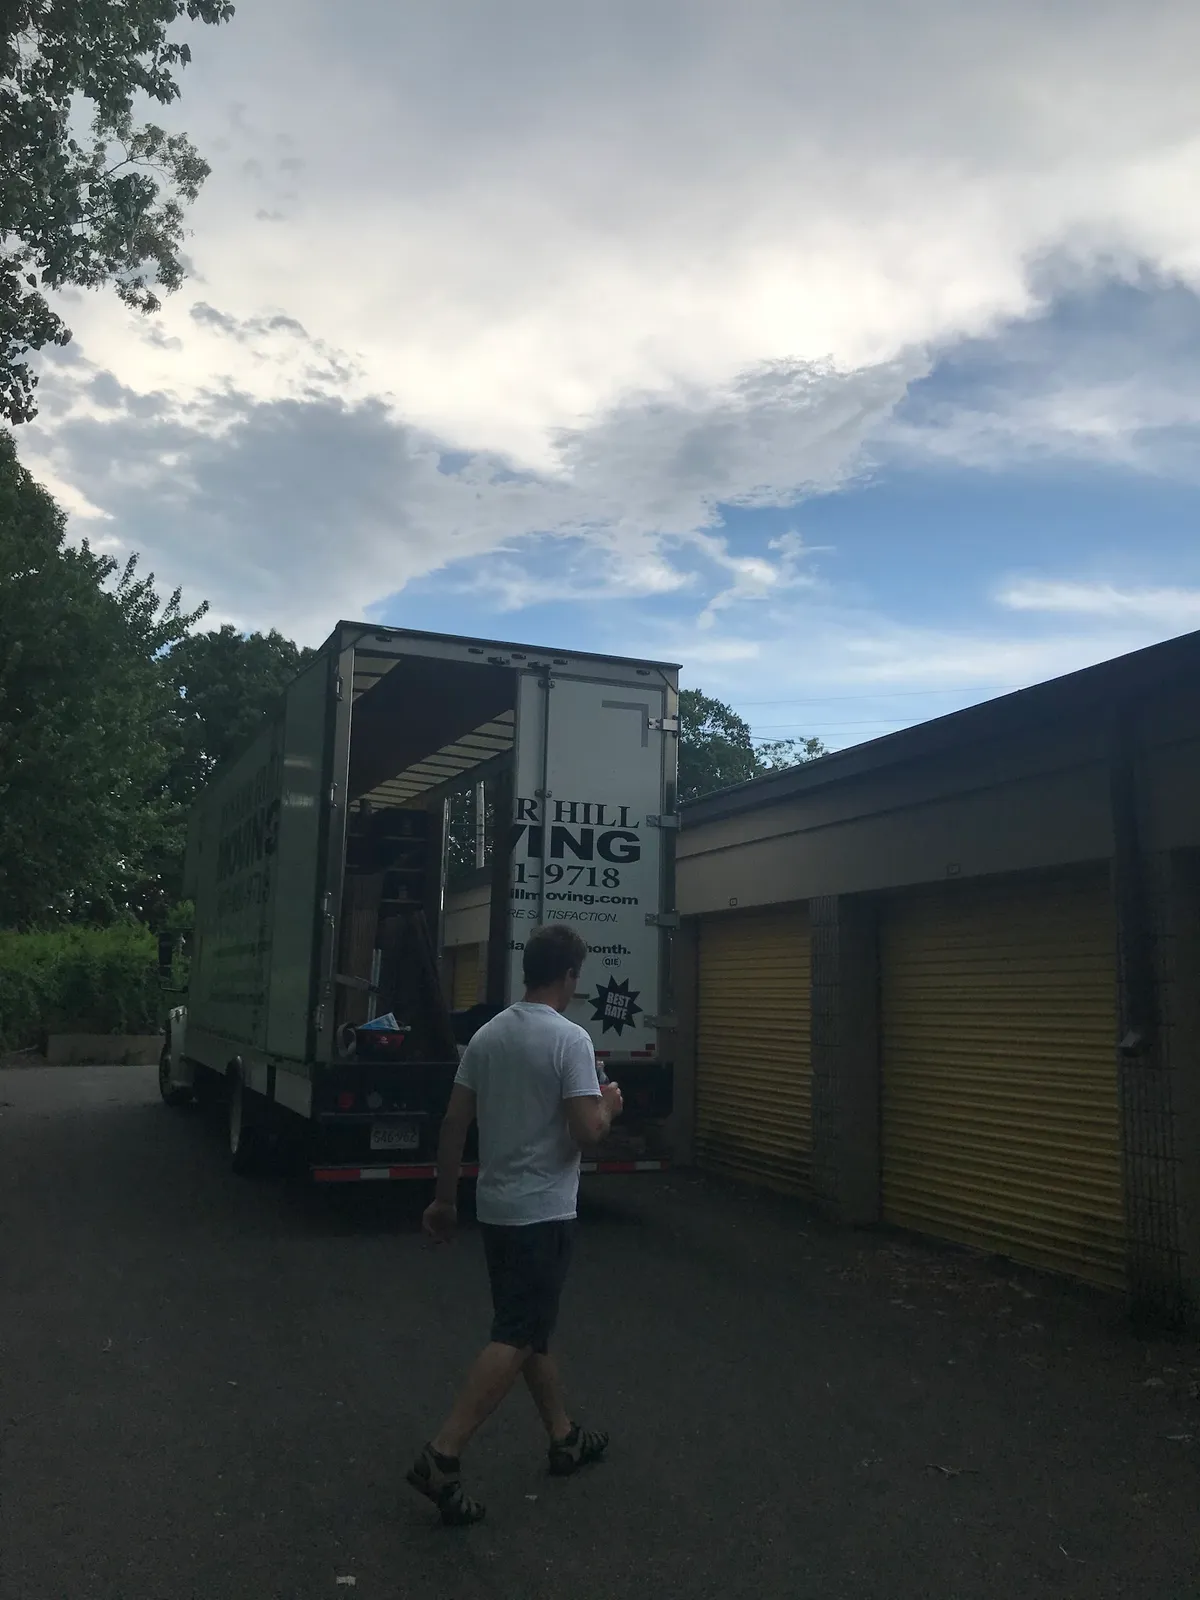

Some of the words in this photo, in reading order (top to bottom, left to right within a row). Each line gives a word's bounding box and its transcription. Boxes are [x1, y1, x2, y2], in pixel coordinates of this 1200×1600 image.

[515, 797, 540, 821] R
[552, 800, 640, 828] HILL
[514, 863, 620, 888] 1-9718
[526, 909, 618, 923] STISFACTION.
[606, 991, 632, 1008] BEST
[604, 1005, 628, 1021] RATE
